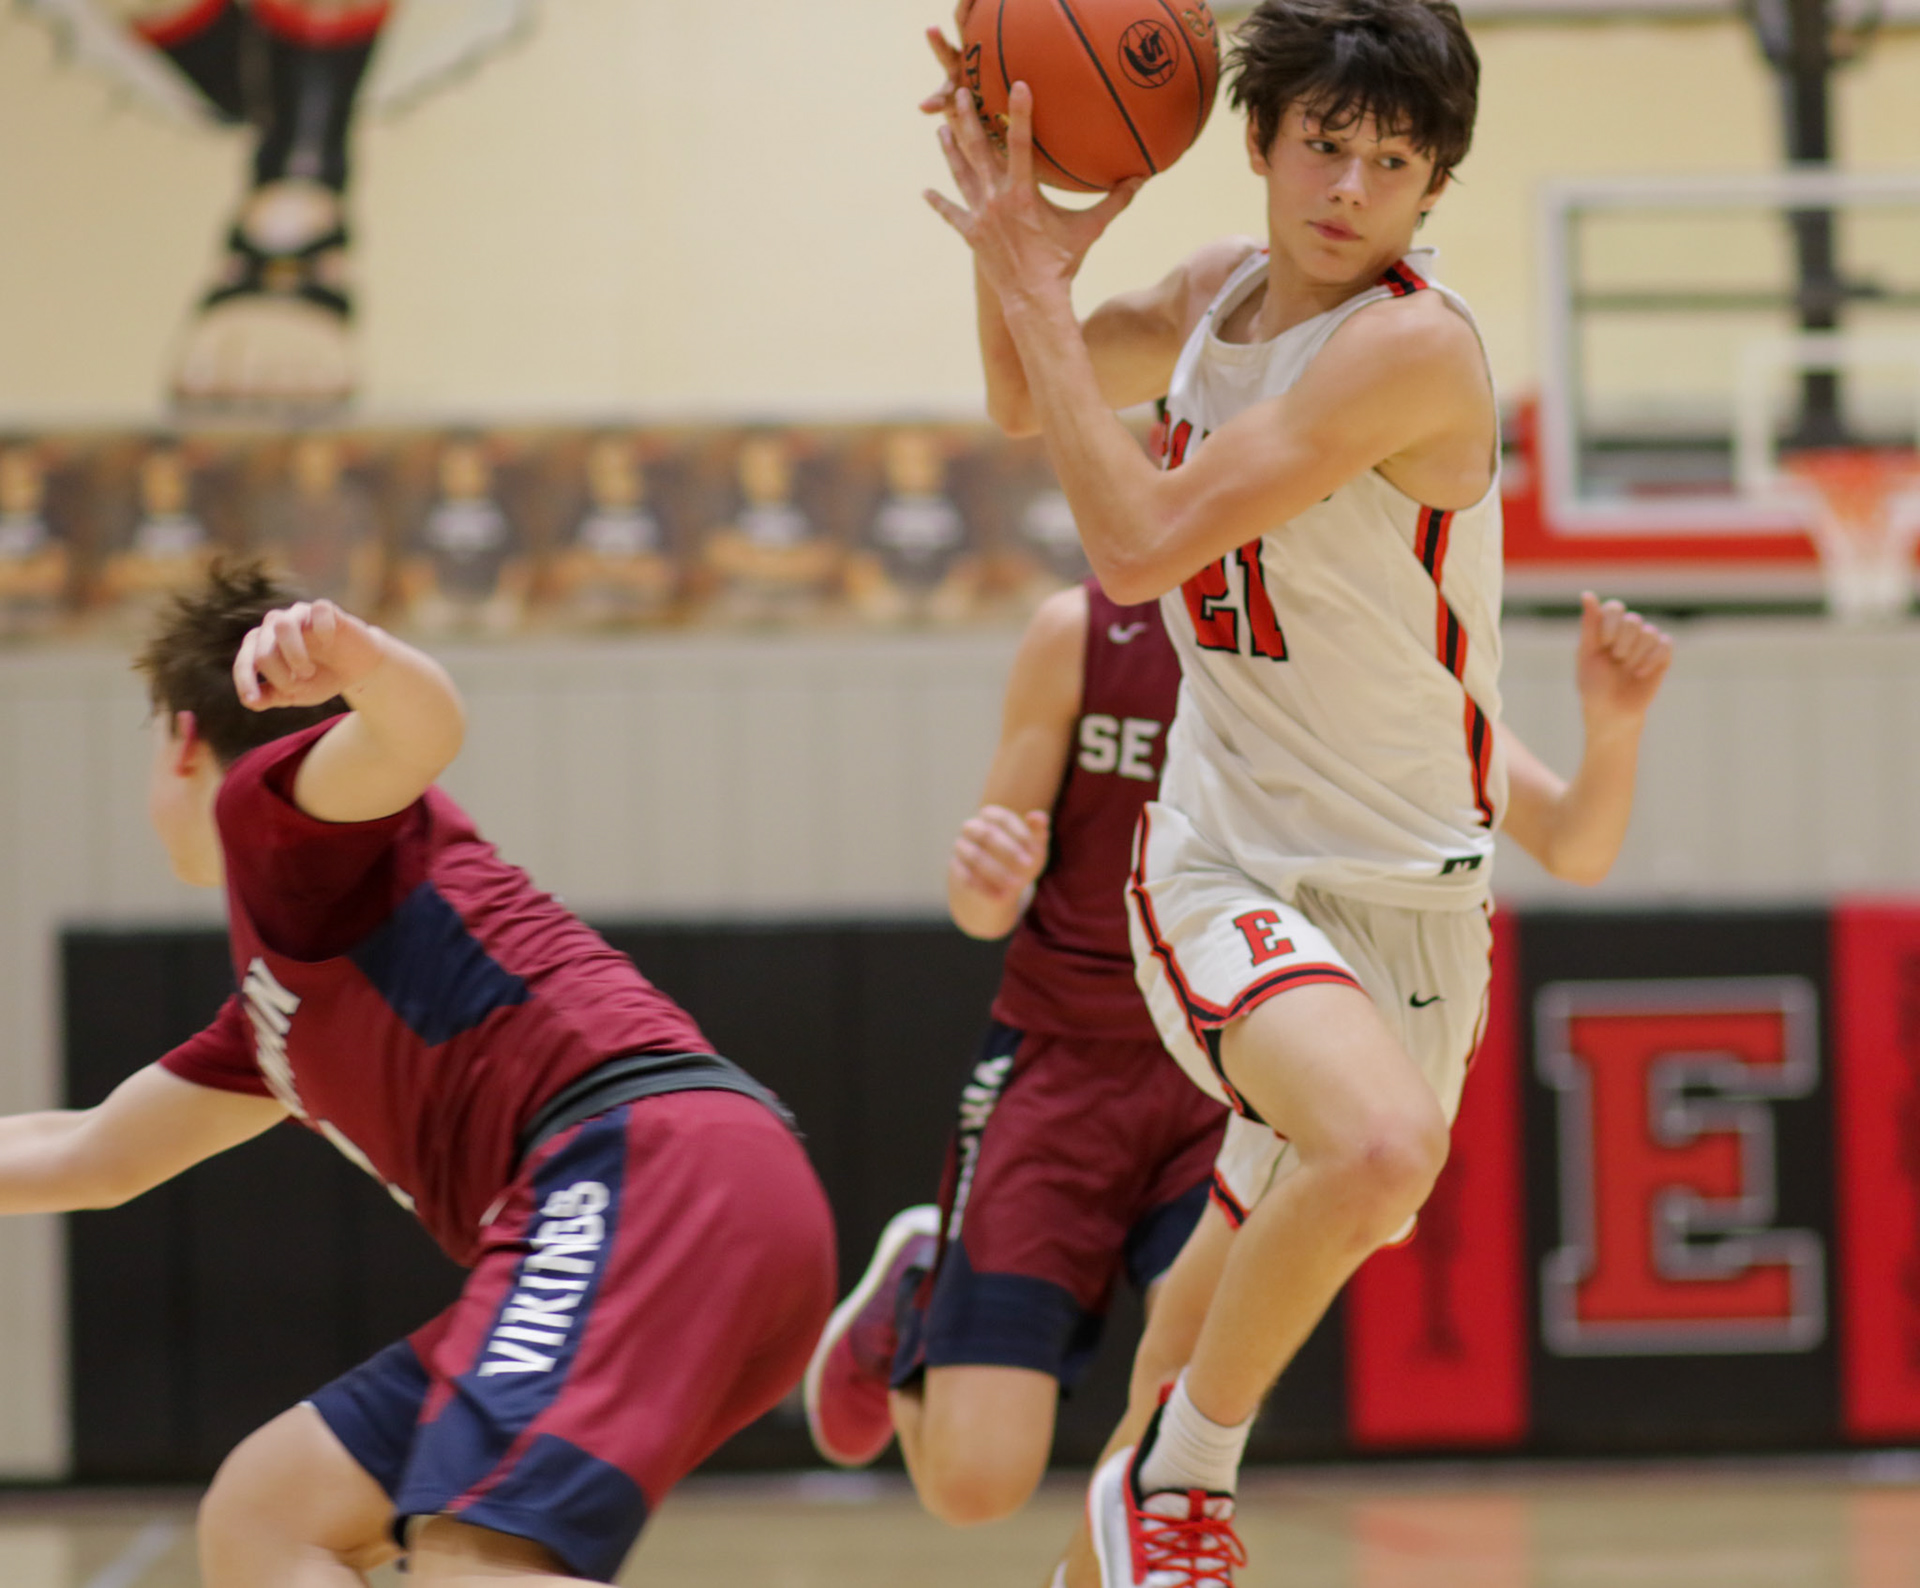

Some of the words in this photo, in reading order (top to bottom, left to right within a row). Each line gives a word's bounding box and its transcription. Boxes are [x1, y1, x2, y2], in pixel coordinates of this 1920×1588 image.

[1180, 535, 1288, 662] 21
[1233, 909, 1296, 967] E
[1535, 974, 1827, 1358] E
[477, 1180, 611, 1377] VIKINGS
